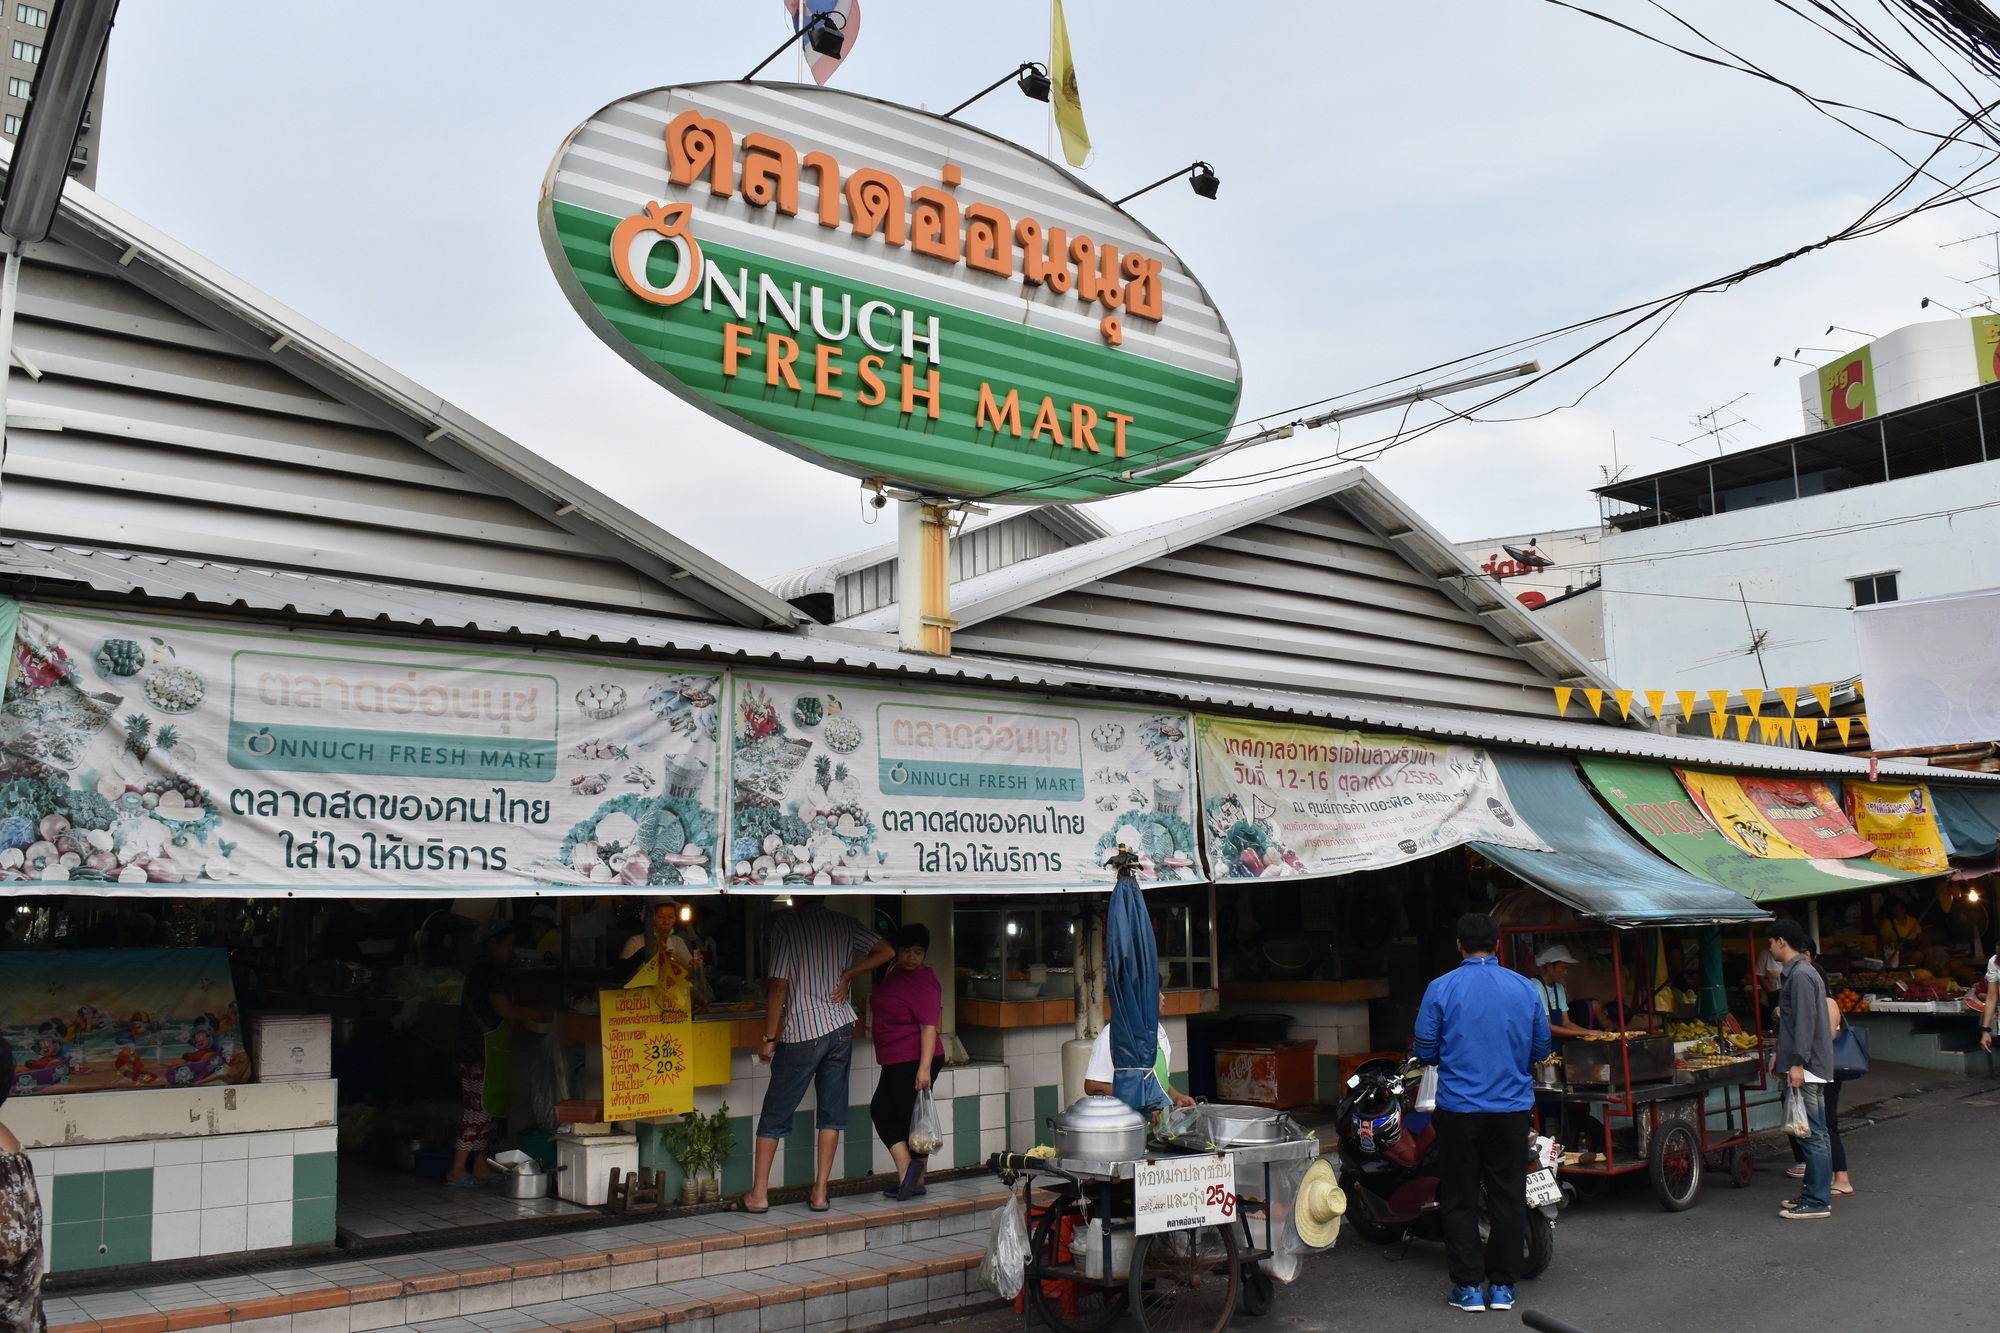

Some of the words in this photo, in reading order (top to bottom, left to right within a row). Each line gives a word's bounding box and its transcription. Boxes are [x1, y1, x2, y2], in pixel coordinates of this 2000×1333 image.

[664, 110, 1163, 346] ตลาดอ่อนนุช
[613, 208, 940, 364] ONNUCH
[723, 322, 940, 420] FRESH
[976, 382, 1134, 459] MART
[1826, 369, 1849, 391] Big
[257, 671, 539, 734] ตลาดอ่อนนุช
[244, 730, 374, 761] ONNUCH
[390, 745, 466, 766] FRESH
[480, 751, 545, 769] MART
[893, 716, 1068, 764] ตลาดอ่อนนุช
[889, 764, 970, 787] ONNUCH
[979, 774, 1027, 790] FRESH
[1035, 777, 1076, 792] MART
[1233, 760, 1268, 786] วันที่
[1276, 769, 1328, 790] 12-16
[1400, 770, 1443, 785] 2558
[230, 787, 550, 824] ตลาดสดของคนไทย
[670, 784, 696, 798] RICE
[882, 806, 1085, 835] ตลาดสดของคนไทย
[278, 830, 508, 871] ใส่ใจให้บริการ
[914, 842, 1062, 872] ใส่ใจให้บริการ
[652, 1045, 660, 1059] 3
[656, 1061, 673, 1073] 20
[1167, 1187, 1205, 1212] และกุ้ง
[1167, 1216, 1206, 1228] ตลาดอ่อนนุช
